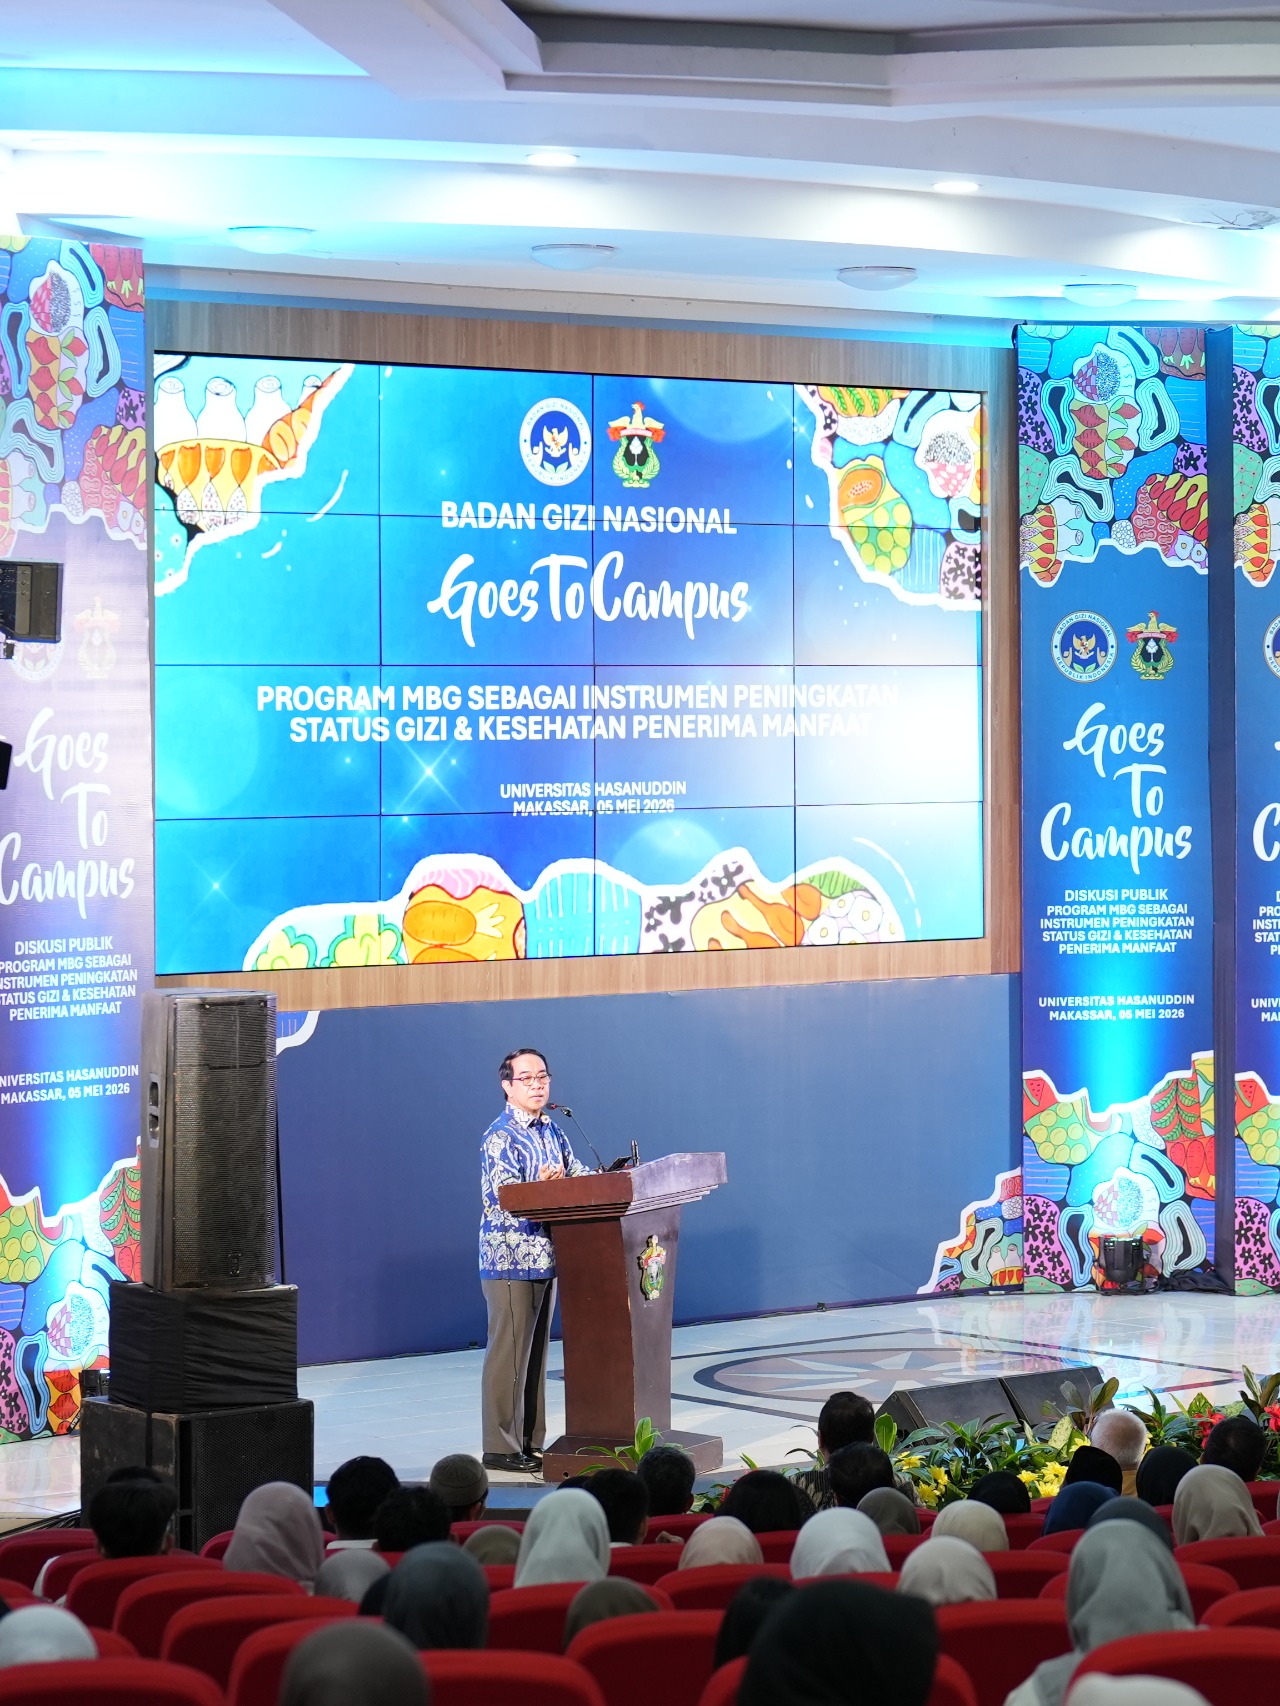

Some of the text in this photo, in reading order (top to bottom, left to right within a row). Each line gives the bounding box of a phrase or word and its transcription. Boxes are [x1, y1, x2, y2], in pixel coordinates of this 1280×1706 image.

[441, 500, 738, 534] BADAN GIZI NASIONAL
[426, 550, 749, 648] Goes To Campus
[257, 683, 898, 711] PROGRAM MBG SEBAGAI INSTRUMEN PENINGKATAN
[289, 712, 873, 742] STATUS GIZI & KESEHATAN PENERIMA MANFAAT
[1063, 702, 1165, 778] Goes
[13, 707, 109, 800] Goes
[500, 780, 687, 798] UNIVERSITAS HASANUDDIN
[1113, 762, 1167, 818] To
[61, 782, 111, 850] To
[513, 798, 675, 817] MAKASSAR, 05 MEI 2026
[1040, 802, 1193, 875] Campus
[0, 832, 135, 920] Campus
[1064, 888, 1169, 902] DISKUSI PUBLIK
[1046, 903, 1188, 916] PROGRAM MBG SEBAGAI
[1040, 916, 1195, 929] INSTRUMEN PENINGKATAN
[14, 935, 114, 955] DISKUSI PUBLIK
[1042, 929, 1193, 942] STATUS GIZI & KESEHATAN
[1059, 941, 1177, 955] PENERIMA MANFAAT
[57, 956, 83, 971] MBG
[84, 953, 132, 969] SEBAGAI
[0, 969, 138, 990] STRUMEN PENINGKATAN
[0, 984, 136, 1006] TATUS GIZI & KESEHATAN
[1038, 994, 1195, 1007] UNIVERSITAS HASANUDDIN
[9, 1001, 122, 1021] PENERIMA MANFAAT
[1049, 1010, 1116, 1021] MAKASSAR,
[1135, 1009, 1156, 1019] MEI
[1158, 1008, 1185, 1019] 2026
[0, 1064, 139, 1088] NIVERSITAS HASANUDDIN
[0, 1088, 66, 1105] MAKASSAR,
[83, 1084, 103, 1098] MEI
[105, 1082, 130, 1096] 2026
